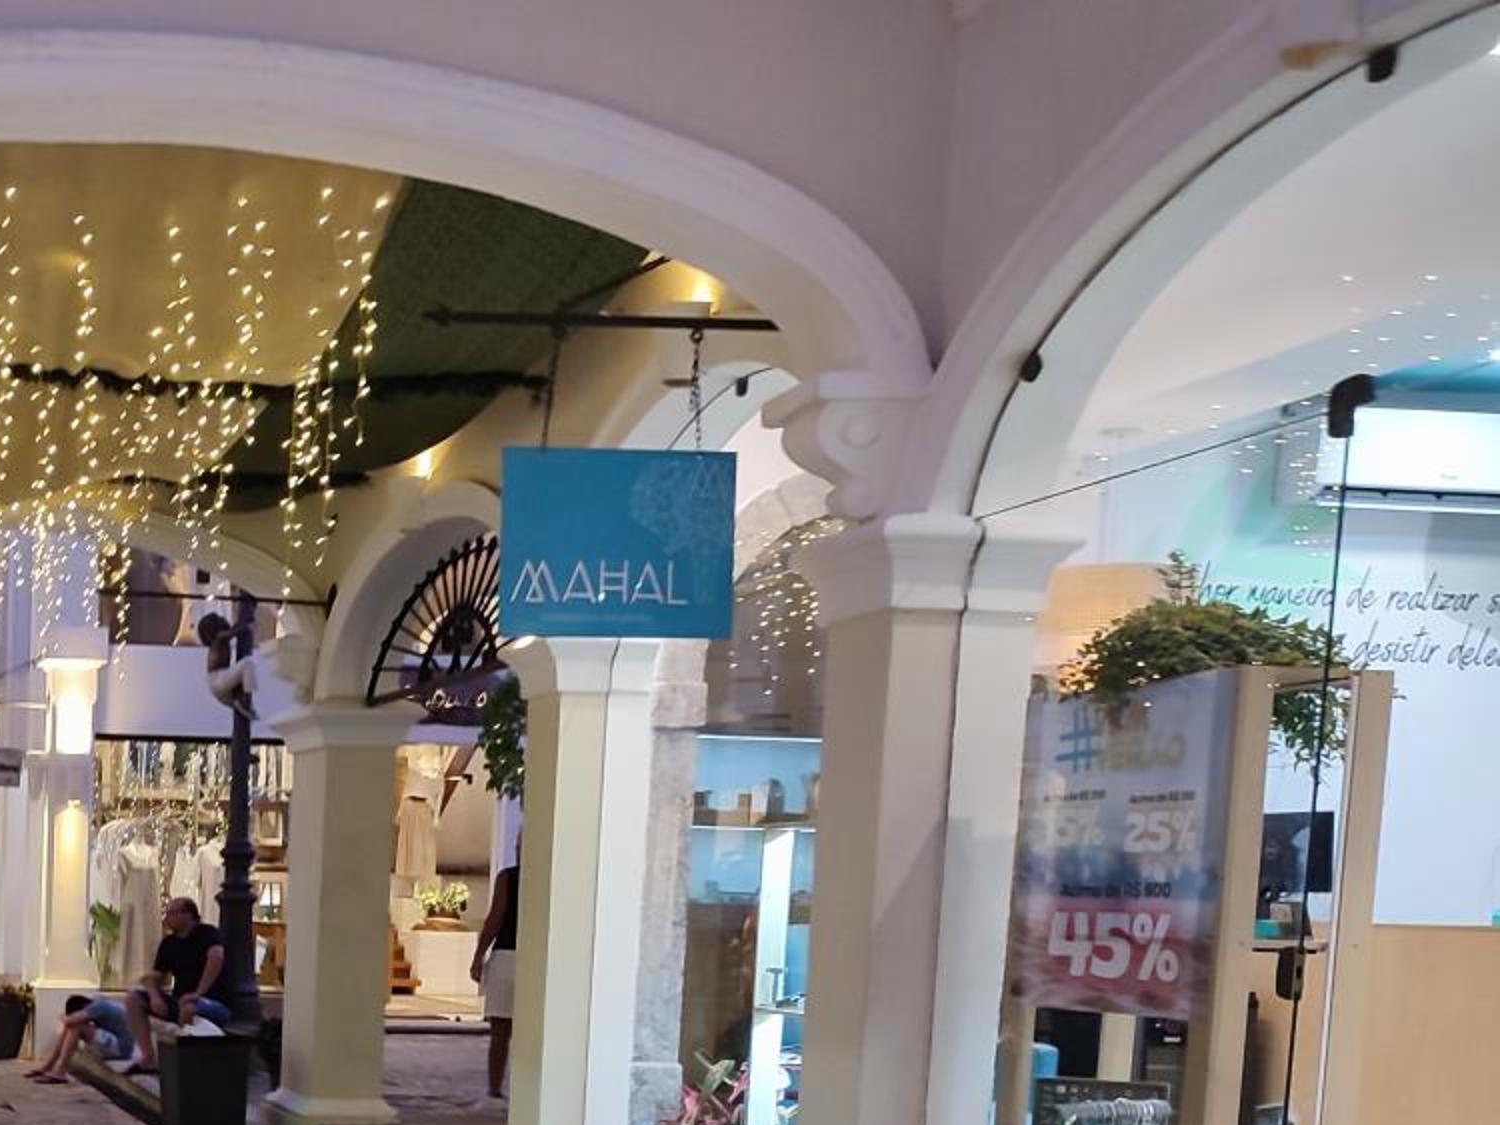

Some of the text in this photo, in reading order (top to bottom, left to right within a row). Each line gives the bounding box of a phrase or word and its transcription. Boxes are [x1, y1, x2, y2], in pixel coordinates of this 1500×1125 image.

[509, 559, 690, 605] MAHAL
[1346, 565, 1374, 614] de
[1385, 571, 1477, 612] realizar
[1351, 619, 1500, 672] desistir dele
[1124, 810, 1198, 854] 25%
[1048, 910, 1181, 983] 45%
